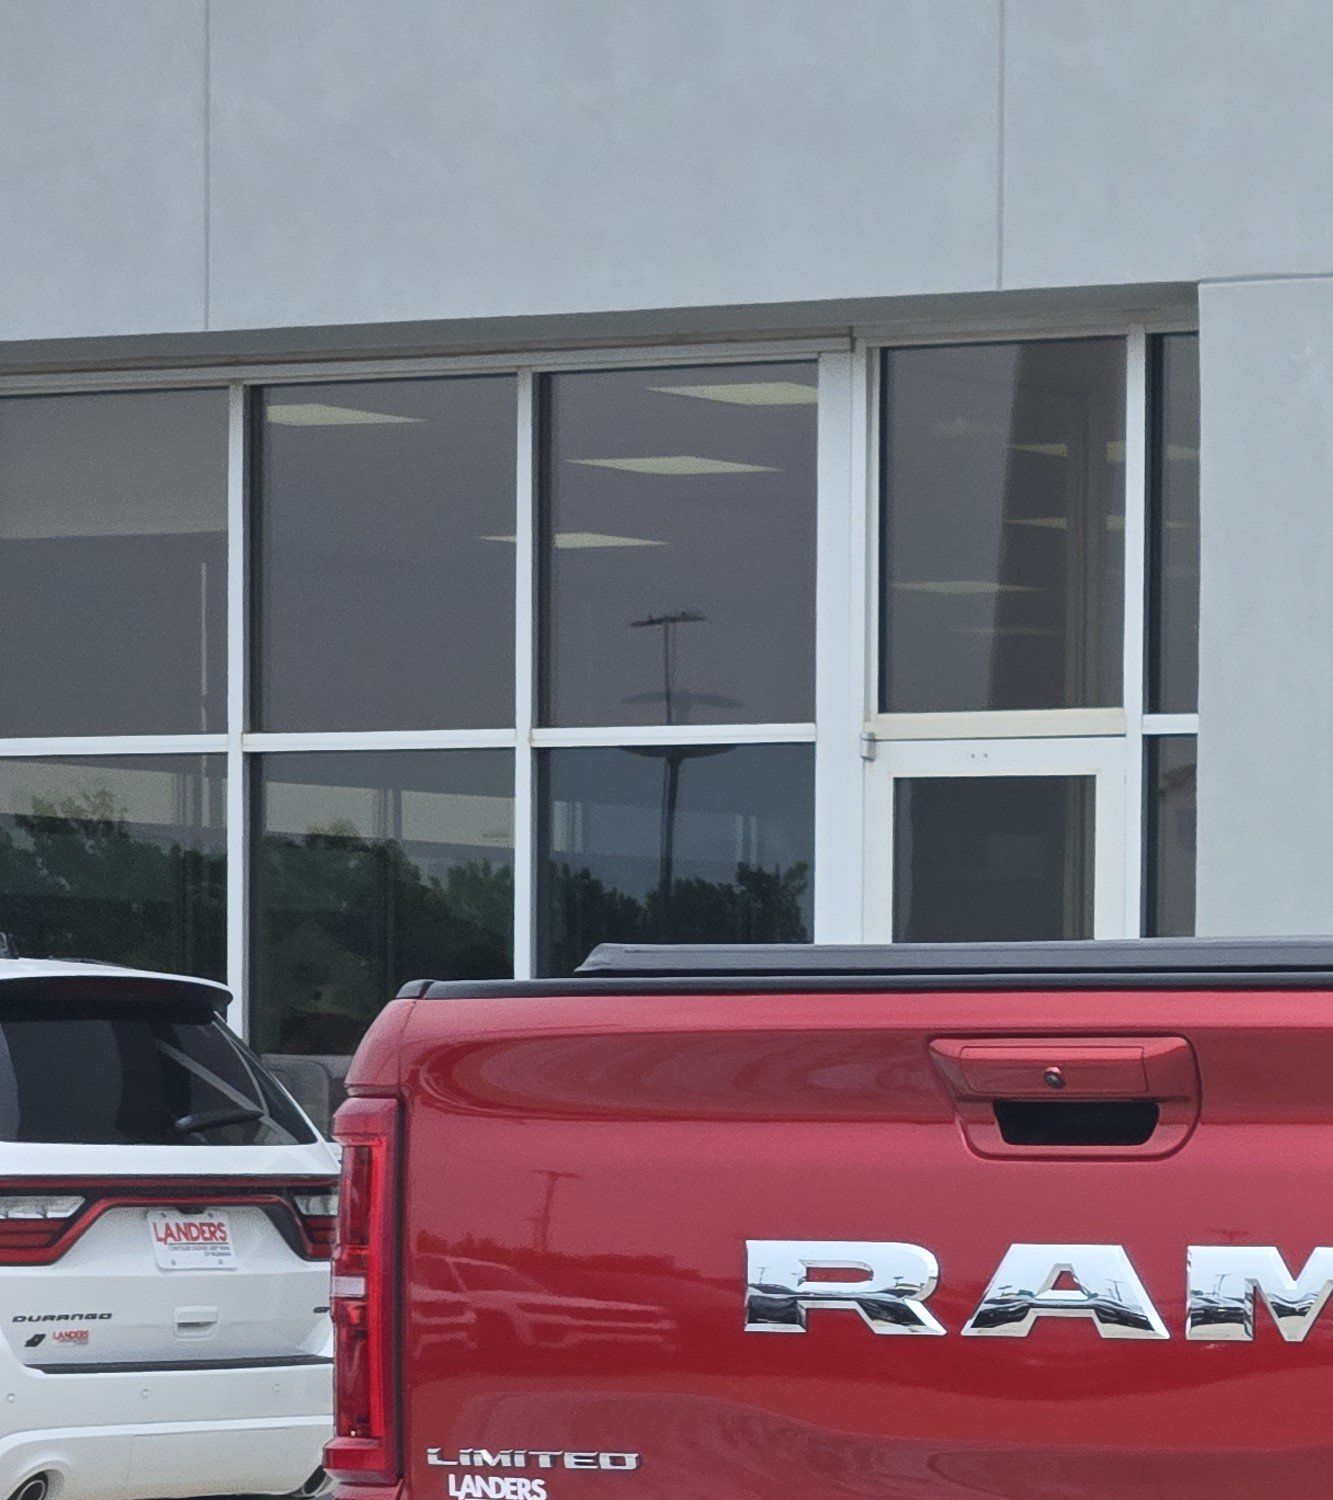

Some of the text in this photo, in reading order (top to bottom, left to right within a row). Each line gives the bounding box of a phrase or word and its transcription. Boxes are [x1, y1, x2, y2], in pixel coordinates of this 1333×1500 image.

[152, 1222, 228, 1245] LANDERS
[12, 1313, 113, 1323] DURANGO
[426, 1447, 639, 1470] LIMITED
